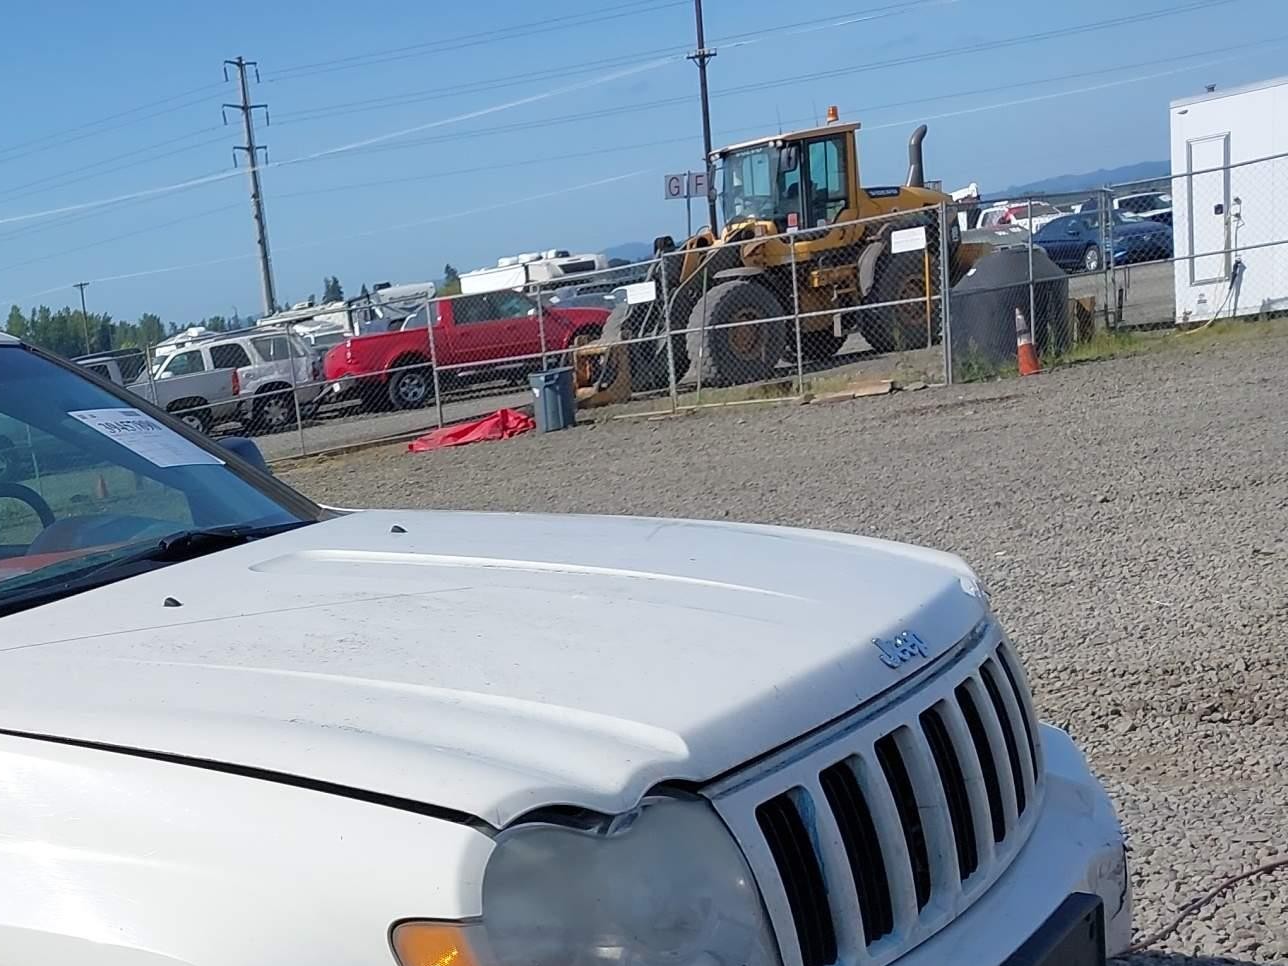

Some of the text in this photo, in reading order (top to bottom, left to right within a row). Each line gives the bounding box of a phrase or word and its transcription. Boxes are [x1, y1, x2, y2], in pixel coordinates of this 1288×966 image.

[668, 176, 681, 197] G
[695, 174, 705, 194] F
[871, 632, 928, 670] Jeep
